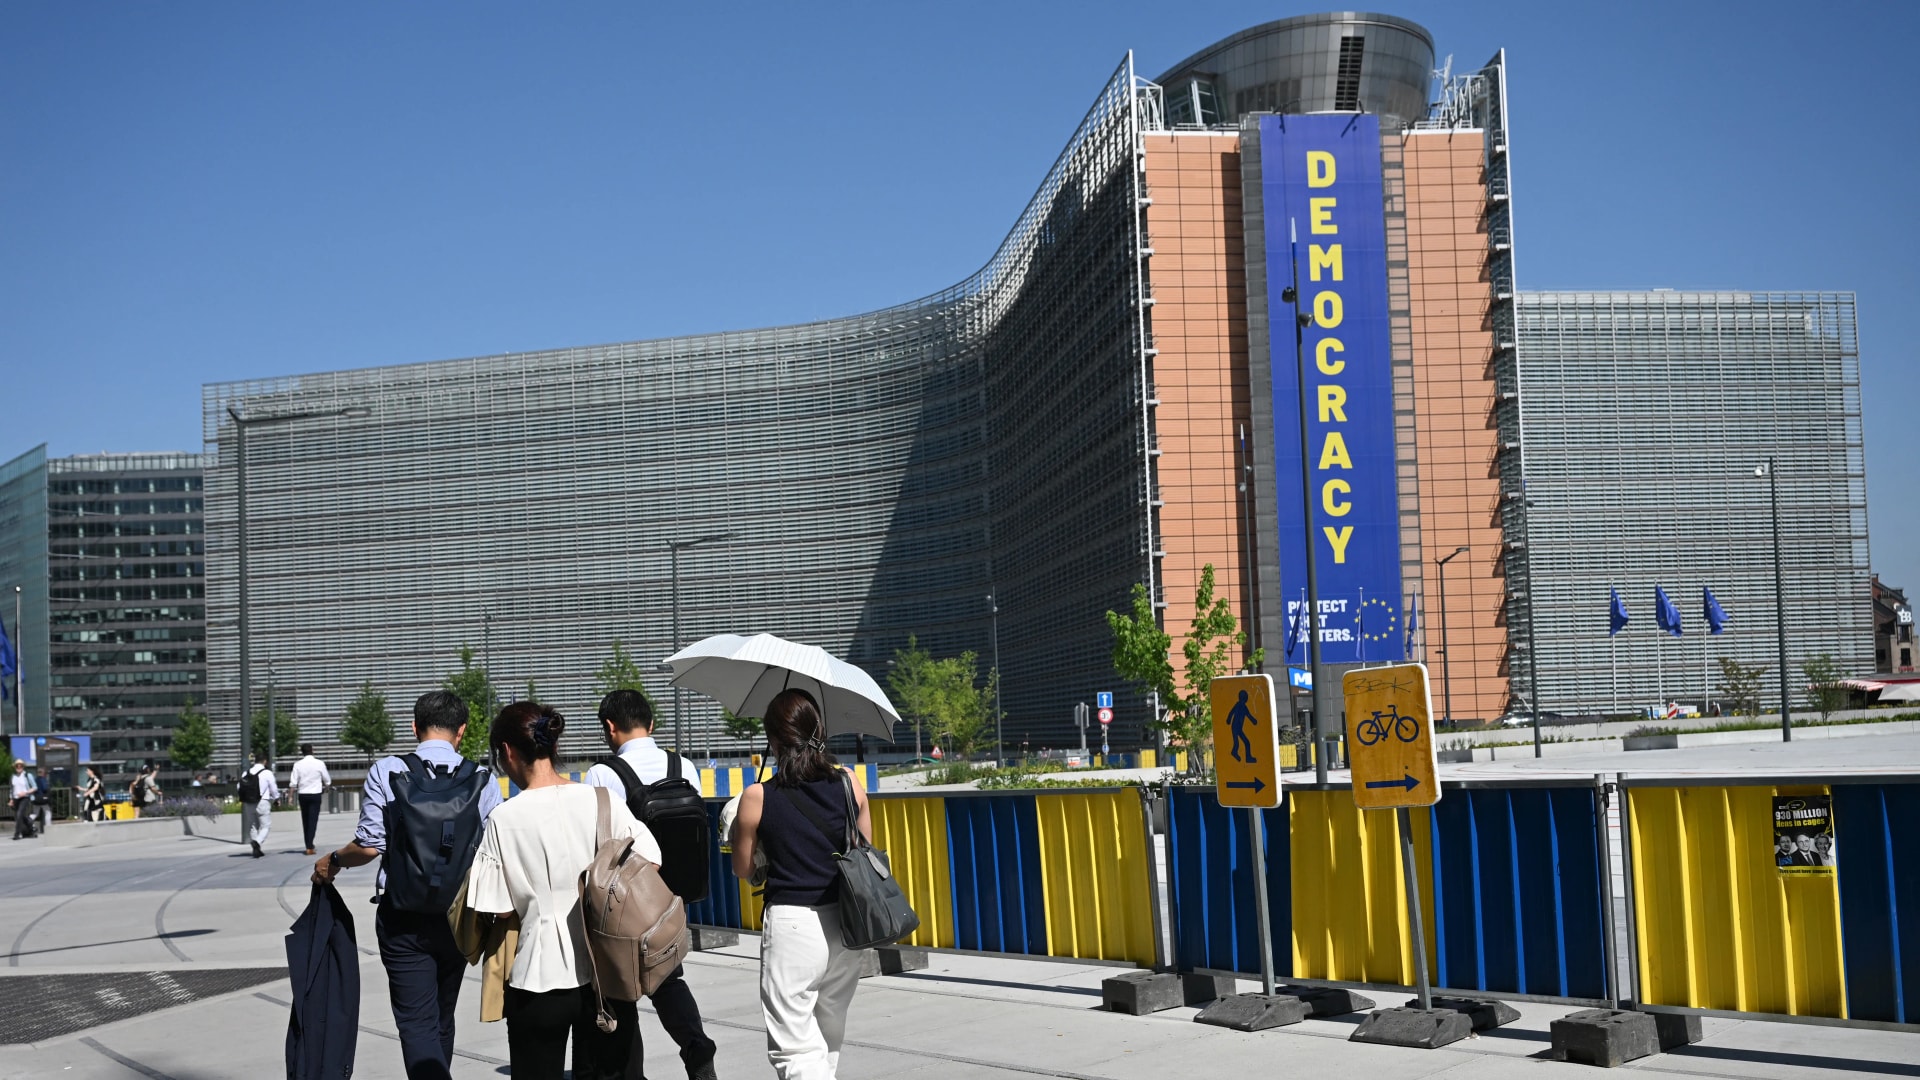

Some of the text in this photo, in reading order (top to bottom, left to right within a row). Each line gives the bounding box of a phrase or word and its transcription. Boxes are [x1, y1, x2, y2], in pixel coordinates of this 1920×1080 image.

[1306, 150, 1354, 565] DEMOCRACY
[1775, 808, 1828, 820] 930 MILLION
[1803, 818, 1825, 826] cages
